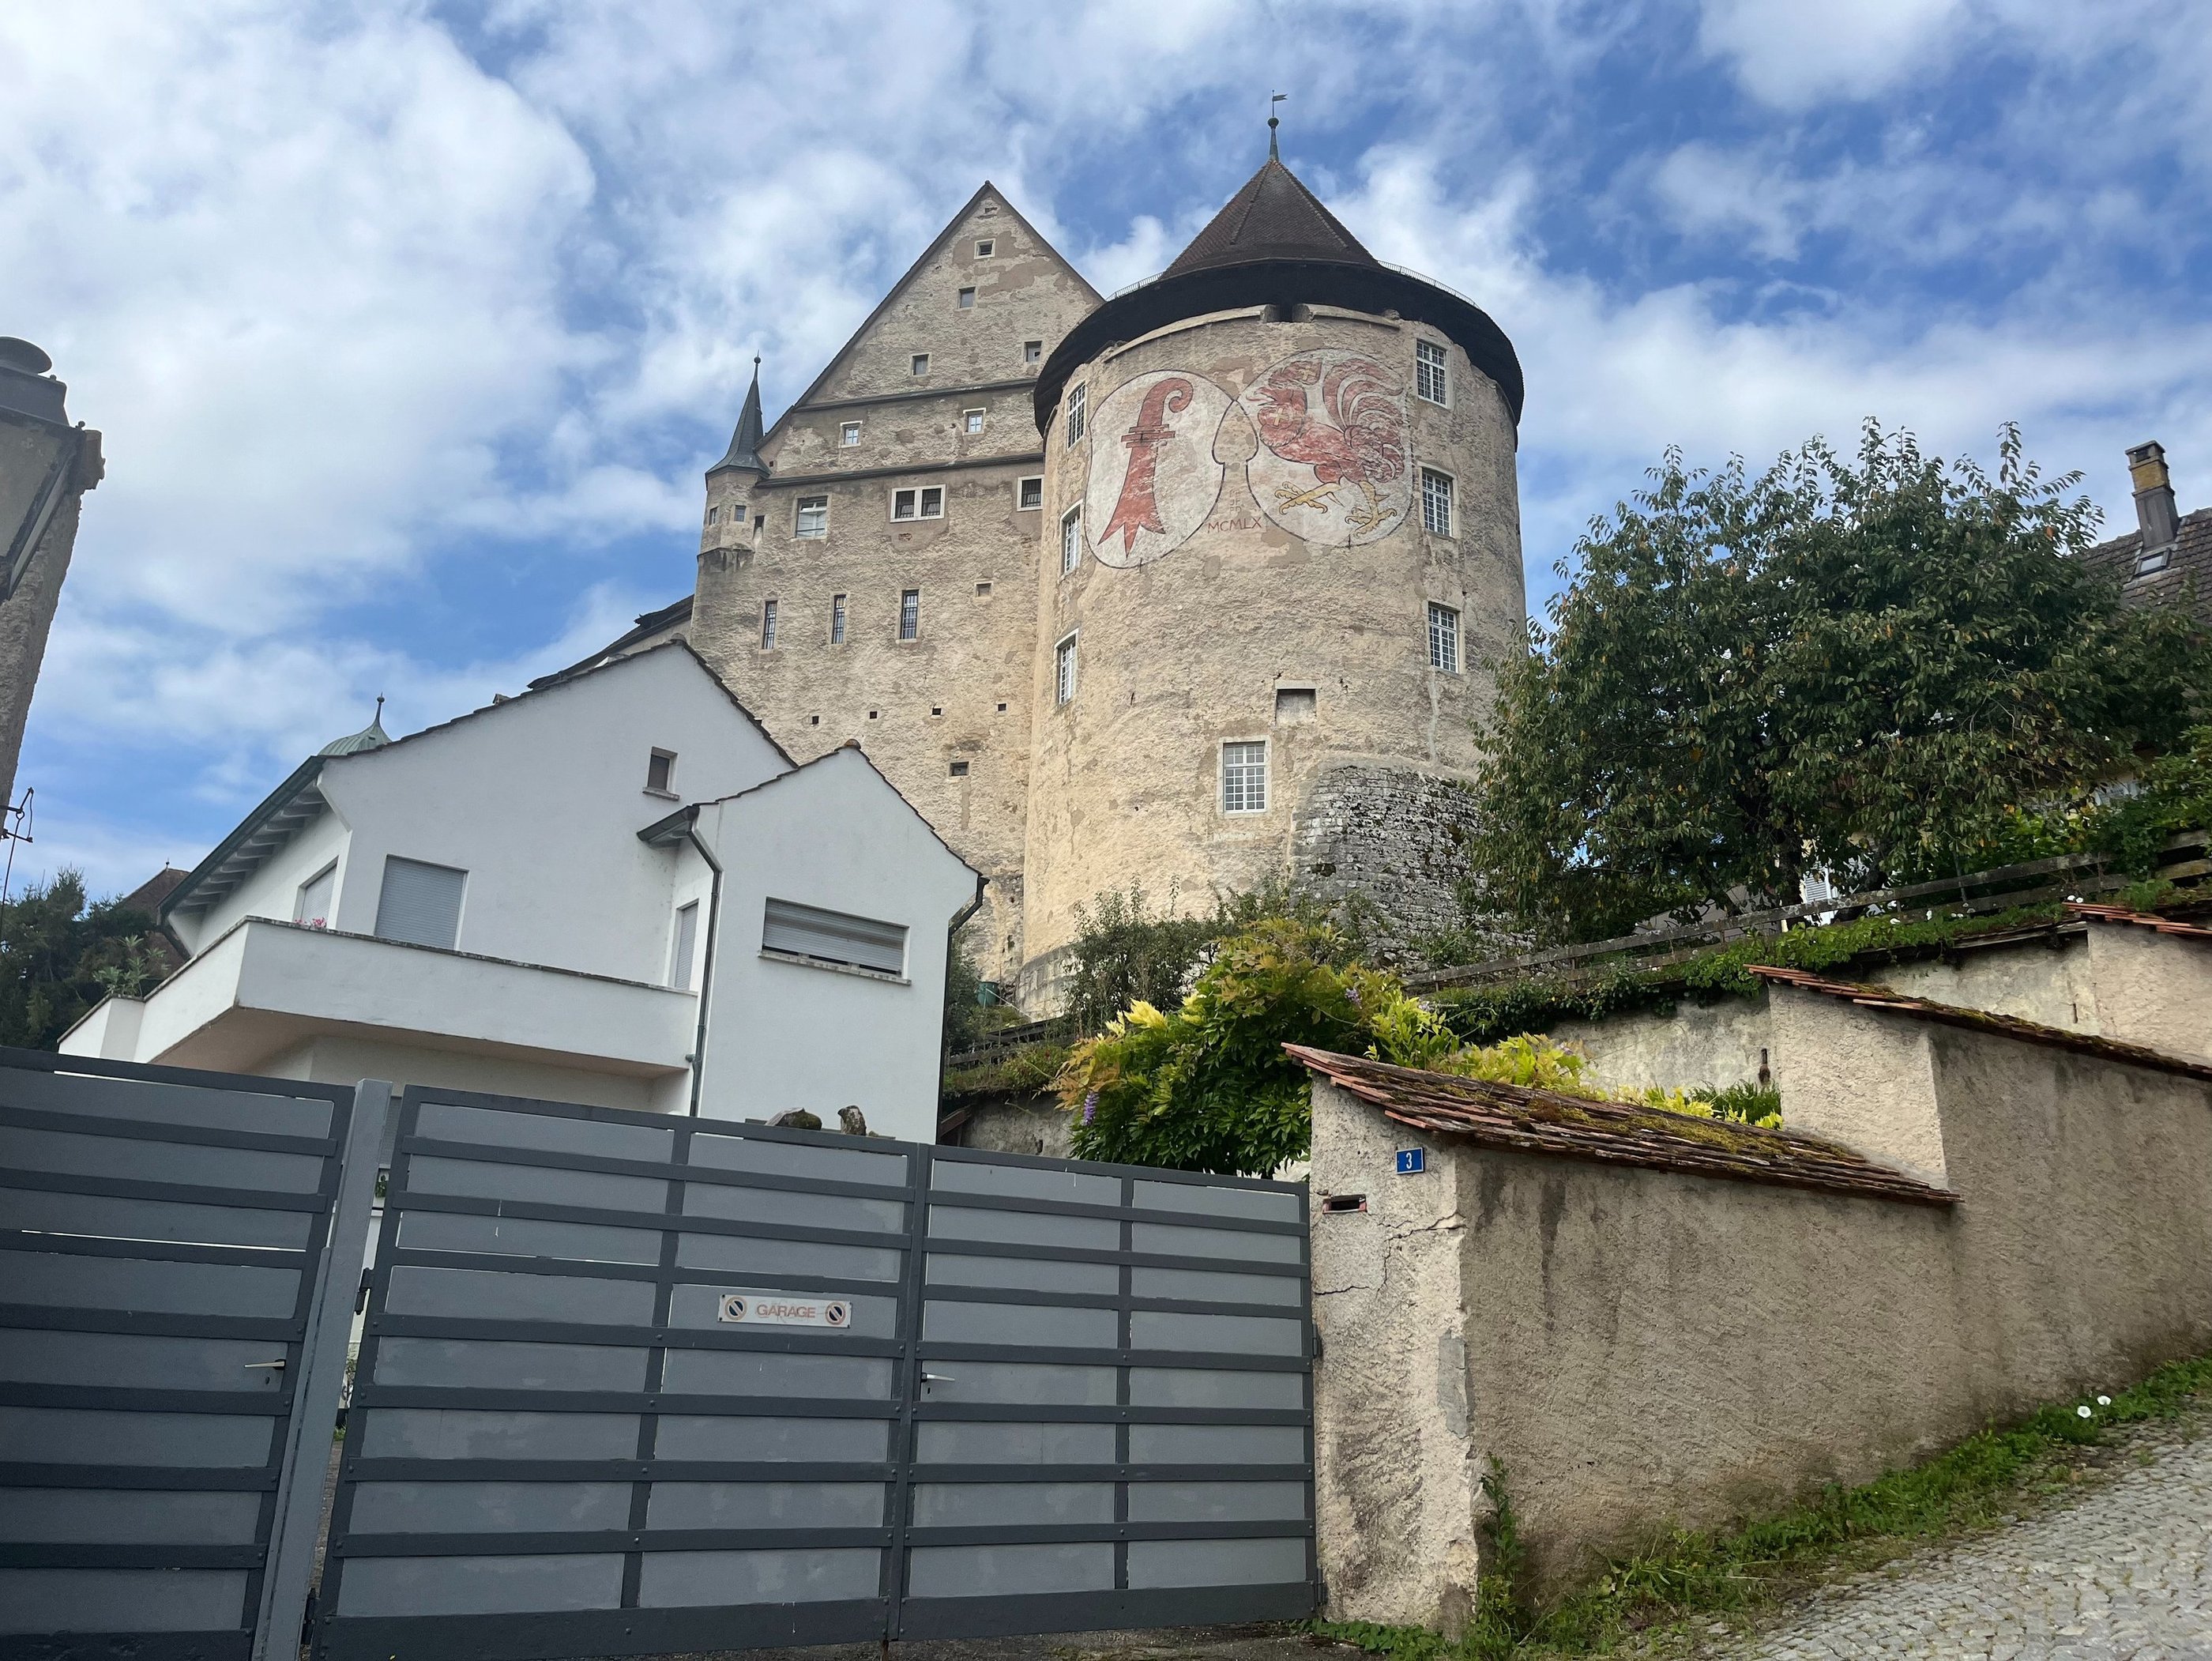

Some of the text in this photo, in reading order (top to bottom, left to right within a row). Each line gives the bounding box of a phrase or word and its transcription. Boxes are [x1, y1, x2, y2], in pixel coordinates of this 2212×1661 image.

[1207, 517, 1262, 533] MCMLX
[1406, 1152, 1413, 1169] 3
[756, 1304, 816, 1319] GARAGE
